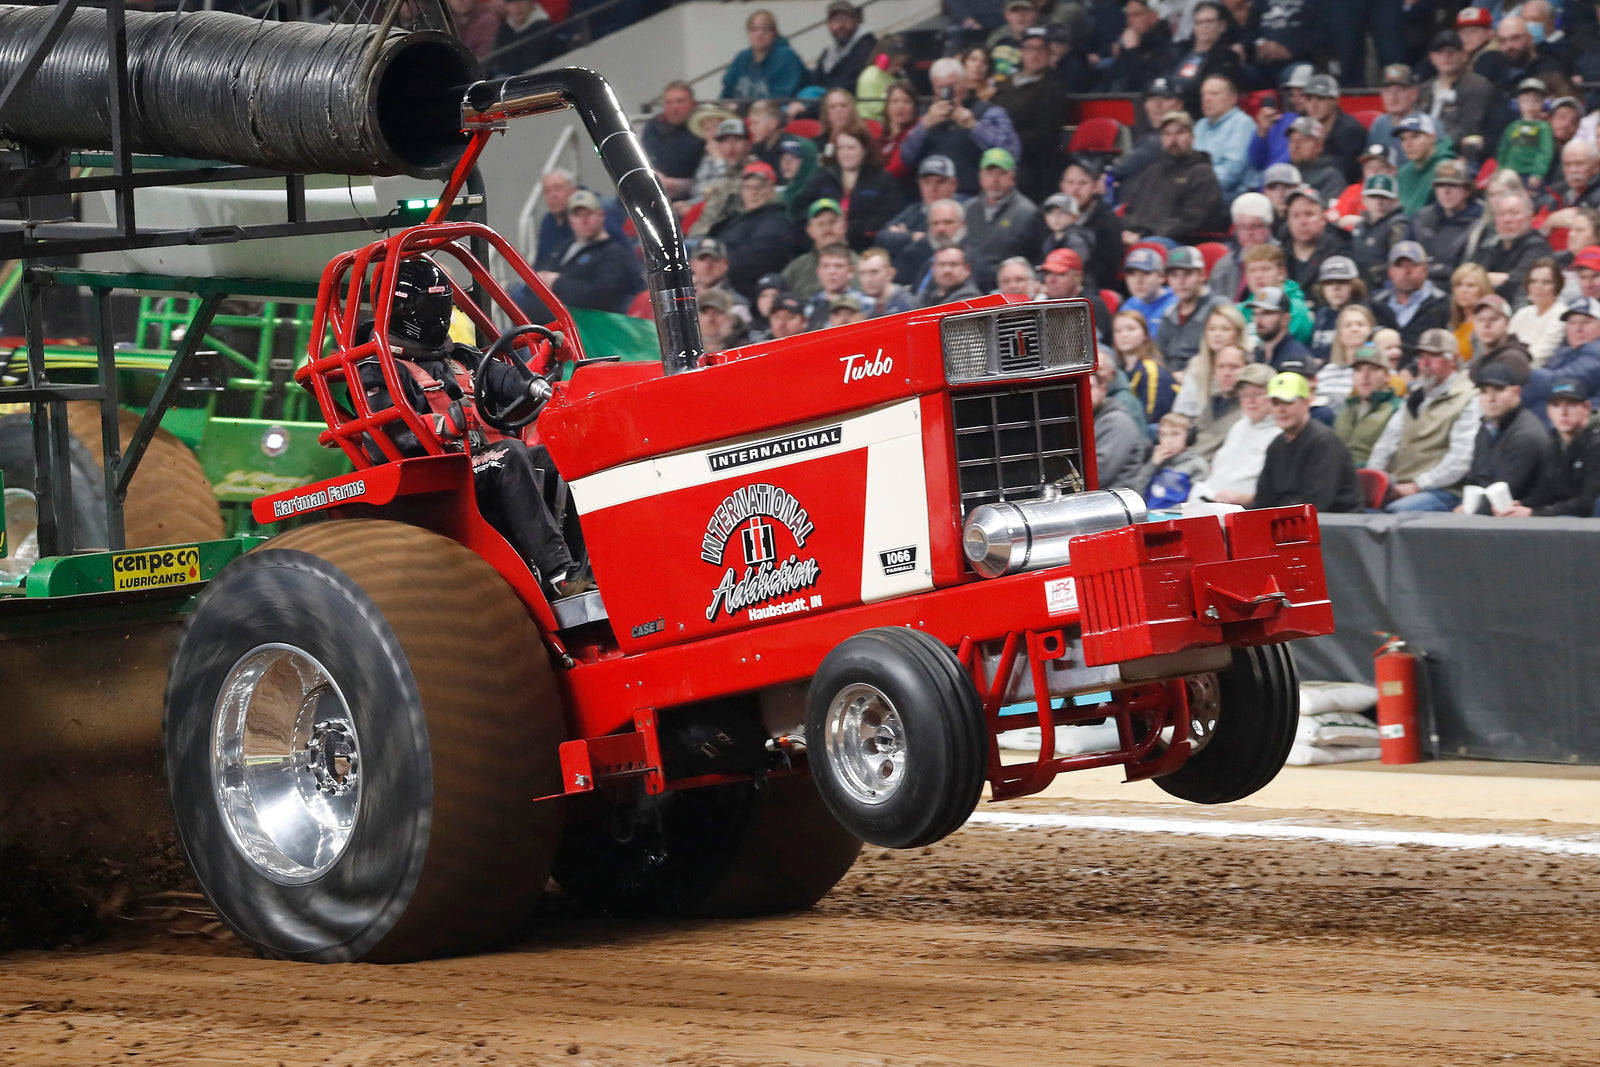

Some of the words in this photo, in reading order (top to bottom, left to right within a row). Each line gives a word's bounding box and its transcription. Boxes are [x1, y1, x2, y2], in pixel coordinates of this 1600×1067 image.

[839, 348, 893, 384] Turbo
[712, 431, 840, 468] INTERNATIONAL
[273, 490, 328, 517] Hartman
[327, 480, 366, 503] Farms
[700, 483, 816, 567] INTERNATIONAL
[886, 549, 911, 566] 1066
[119, 572, 186, 589] LUBRICANTS
[705, 554, 820, 622] Addiction
[748, 597, 810, 621] Haubstadt,
[809, 594, 823, 609] IN
[631, 620, 656, 639] CASE
